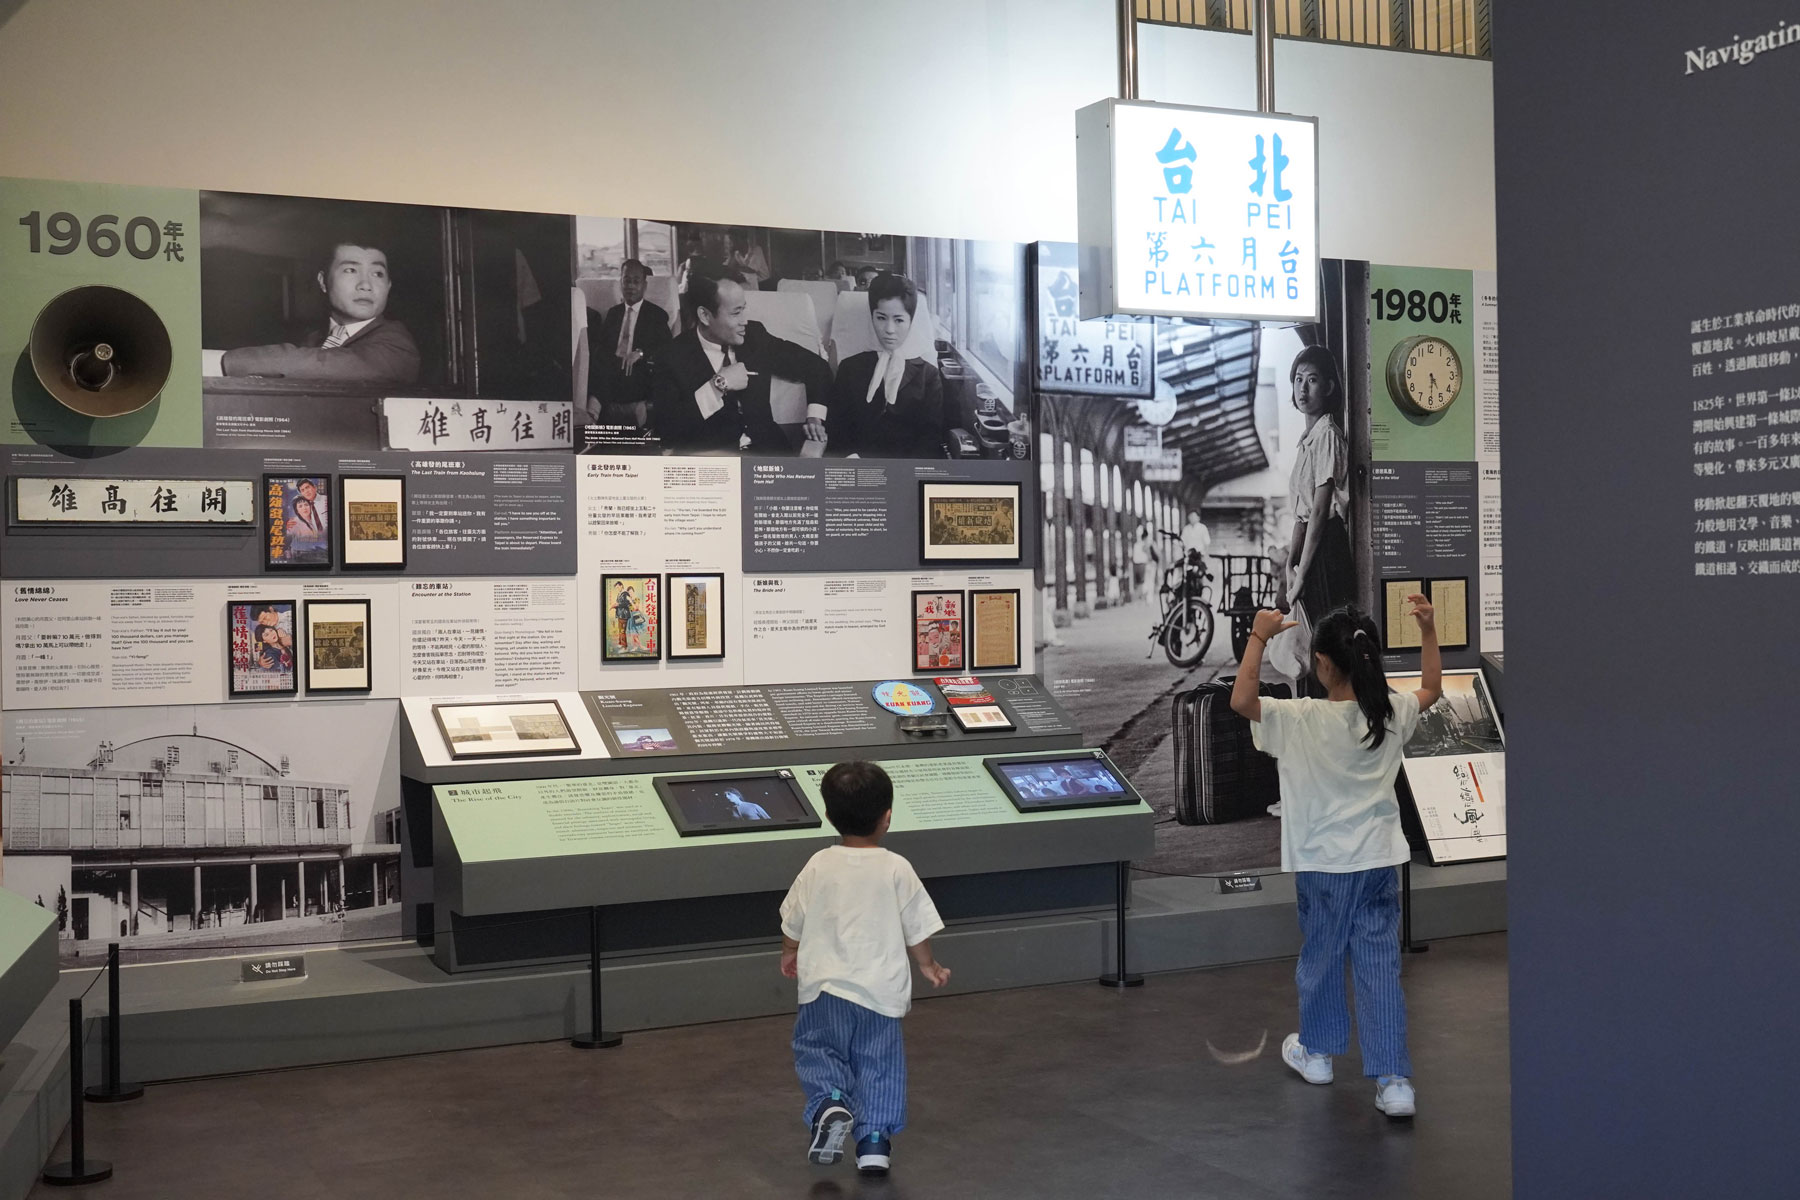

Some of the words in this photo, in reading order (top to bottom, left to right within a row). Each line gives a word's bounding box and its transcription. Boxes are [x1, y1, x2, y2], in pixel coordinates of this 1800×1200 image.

[1684, 20, 1800, 76] Navigatin
[1155, 127, 1293, 202] 台北
[1153, 196, 1197, 224] TAI
[1247, 202, 1291, 230] PEI
[19, 210, 162, 260] 1960
[1146, 231, 1300, 274] 第六月台
[1145, 270, 1275, 299] PLATFORM
[1286, 276, 1298, 300] 6
[1370, 288, 1449, 324] 1980
[1050, 318, 1078, 337] TAI
[1105, 323, 1135, 341] PEI
[1042, 336, 1143, 371] 第六月台
[1044, 364, 1126, 385] PLATFORM
[1131, 370, 1139, 386] 6
